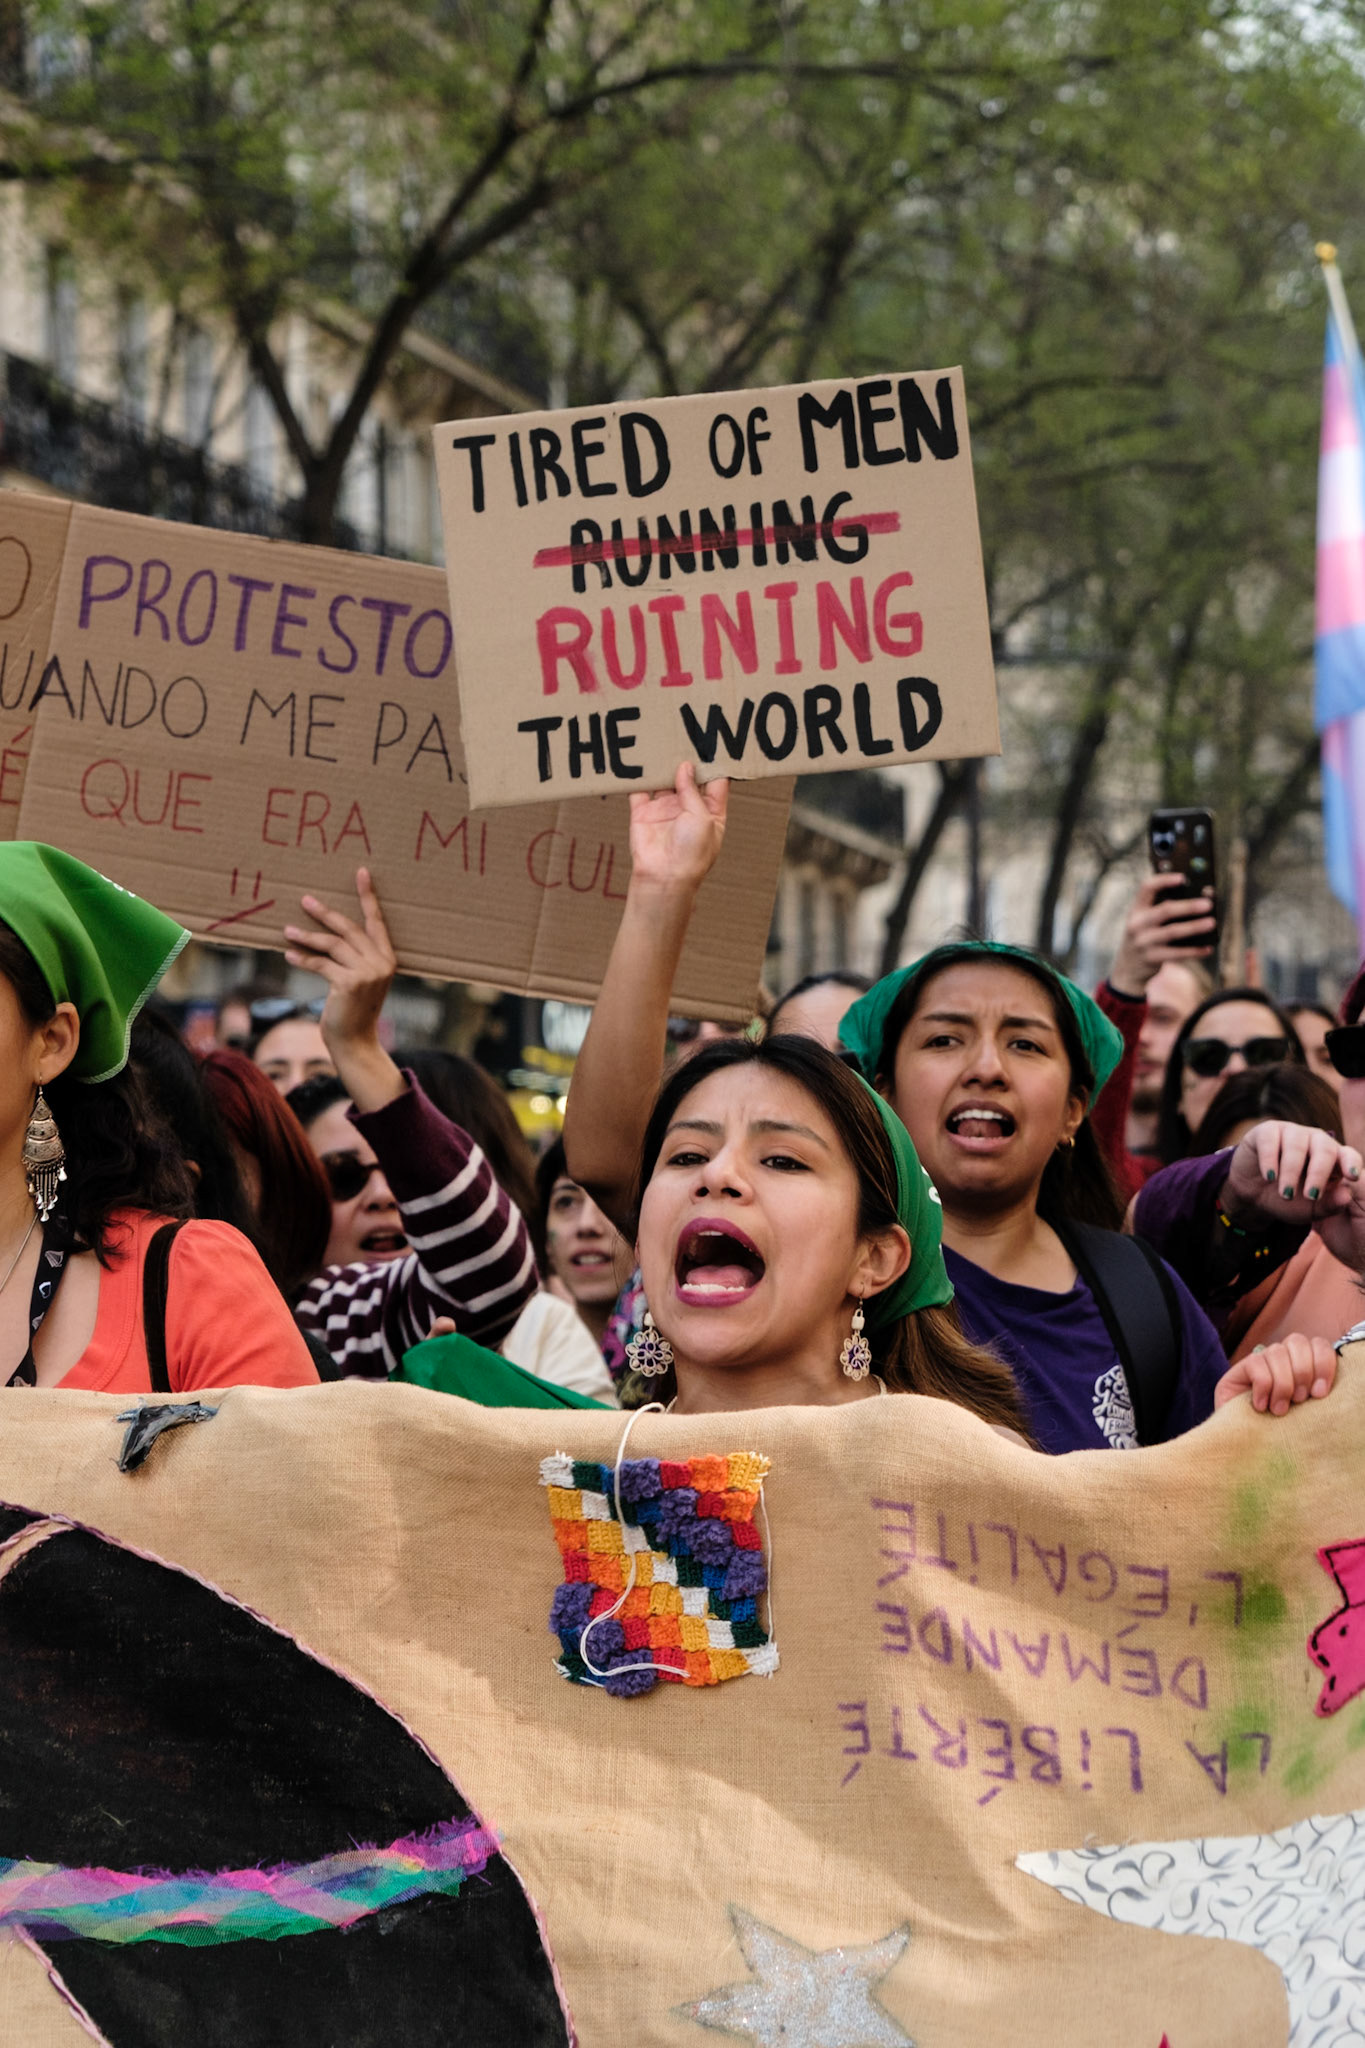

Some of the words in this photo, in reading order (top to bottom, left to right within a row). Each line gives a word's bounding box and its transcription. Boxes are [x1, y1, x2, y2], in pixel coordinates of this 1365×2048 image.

[452, 411, 671, 514] TIRED
[708, 406, 771, 479] OF
[798, 376, 959, 473] MEN
[570, 490, 870, 593] RUNNING
[78, 555, 453, 679] PROTESTO
[535, 571, 924, 696] RUINING
[0, 643, 208, 739] UANDO
[240, 688, 345, 763] ME
[373, 701, 467, 784] PA
[517, 706, 644, 783] THE
[679, 677, 943, 763] WORLD
[80, 759, 212, 834] QUE
[262, 788, 371, 855] ERA
[415, 810, 487, 877] MI
[526, 829, 629, 901] CUL
[1185, 1730, 1272, 1795] LA
